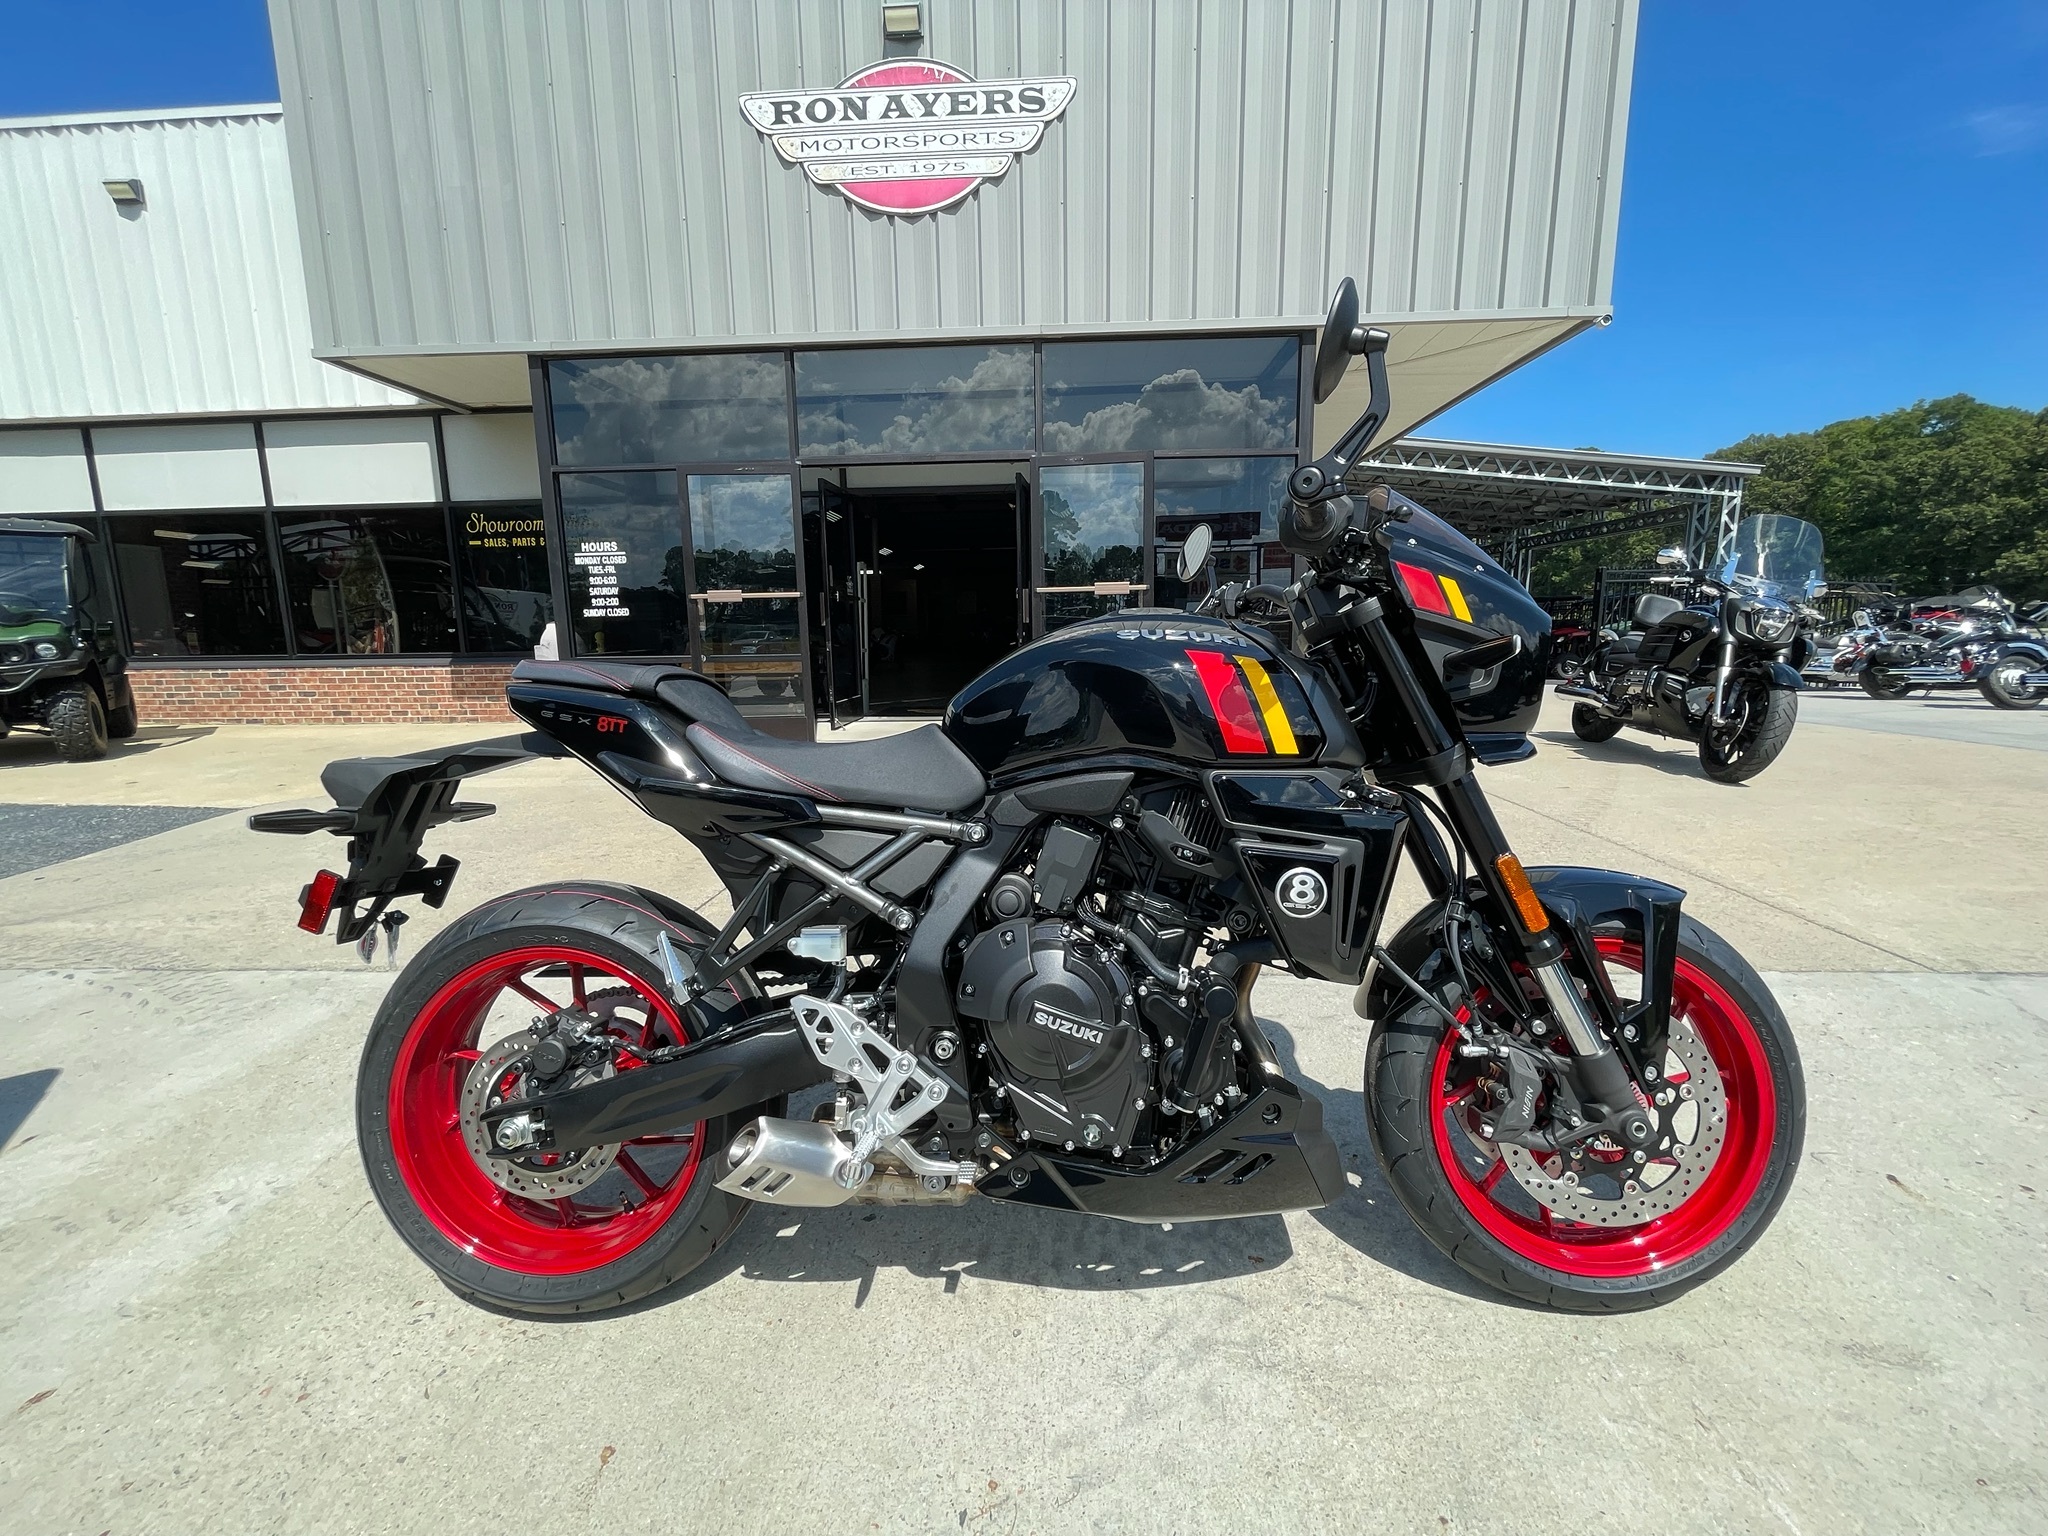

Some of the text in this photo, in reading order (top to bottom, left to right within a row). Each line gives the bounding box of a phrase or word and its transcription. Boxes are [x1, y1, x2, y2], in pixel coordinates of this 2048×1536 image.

[769, 86, 1046, 126] RON AYERS
[800, 130, 1016, 153] MOTORSPORTS
[850, 161, 967, 176] EST. 1975
[466, 512, 544, 535] Showroom
[483, 538, 510, 548] SALES,
[512, 537, 536, 547] PARTS
[580, 541, 618, 552] HOURS
[574, 555, 627, 565] MONDAY CLOSED
[588, 576, 617, 585] 9:00-6:00
[588, 587, 619, 596] SATURDAY
[591, 597, 619, 607] 9:00-2:00
[583, 607, 630, 617] SUNDAY CLOSED
[1116, 629, 1248, 648] SUZUKI
[597, 717, 629, 733] 8TT
[1289, 874, 1315, 903] 8
[1033, 1011, 1104, 1045] SUZUKI
